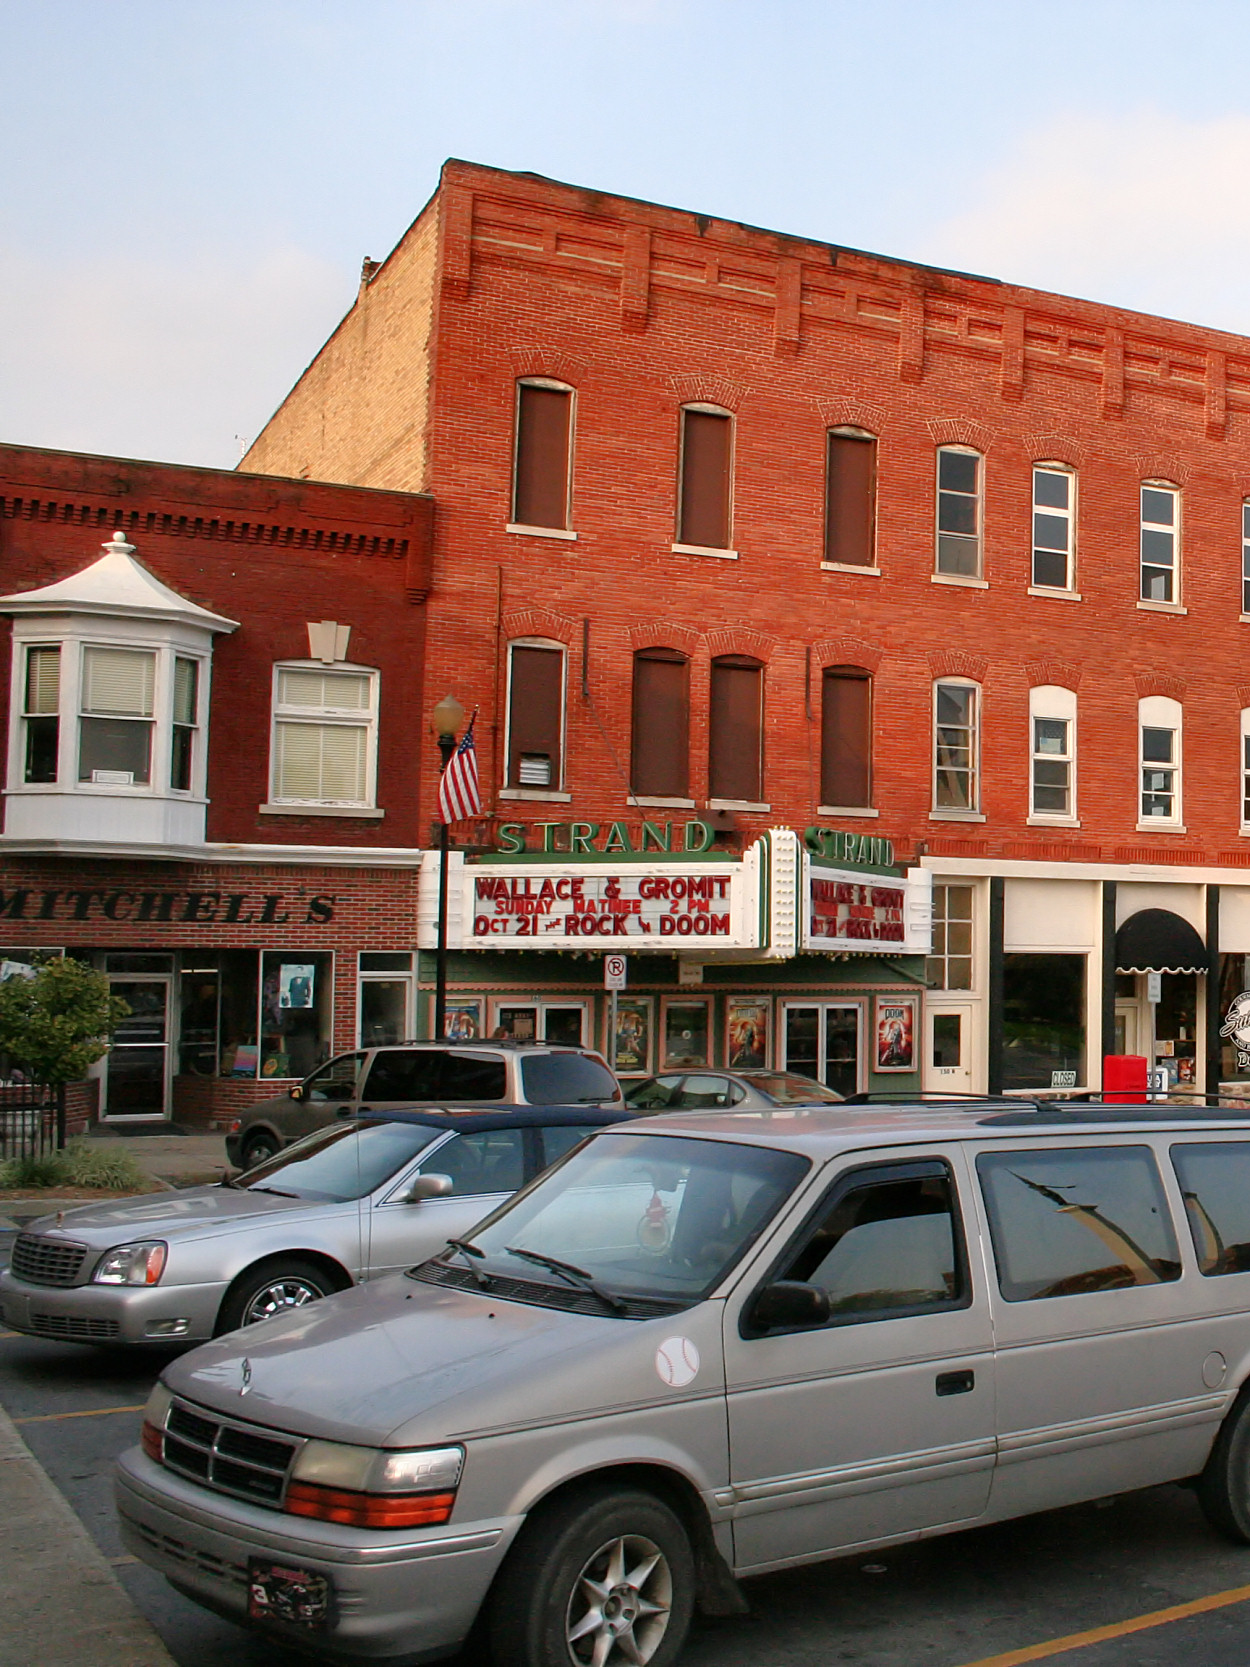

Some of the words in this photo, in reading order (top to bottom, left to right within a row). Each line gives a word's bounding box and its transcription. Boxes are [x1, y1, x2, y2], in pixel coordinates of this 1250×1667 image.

[497, 822, 715, 854] STRAND
[804, 826, 895, 867] STRAND
[475, 877, 584, 900] WALLACE
[604, 877, 620, 899] &
[639, 876, 730, 899] GROMIT
[494, 900, 553, 915] SUNDAY
[574, 900, 642, 914] MATINEE
[669, 900, 679, 914] 2
[688, 900, 709, 913] PM
[516, 915, 538, 936] 21
[565, 914, 629, 936] ROCK
[660, 913, 730, 936] DOOM
[885, 1008, 905, 1020] DOOM
[1052, 1072, 1075, 1086] CLOSED
